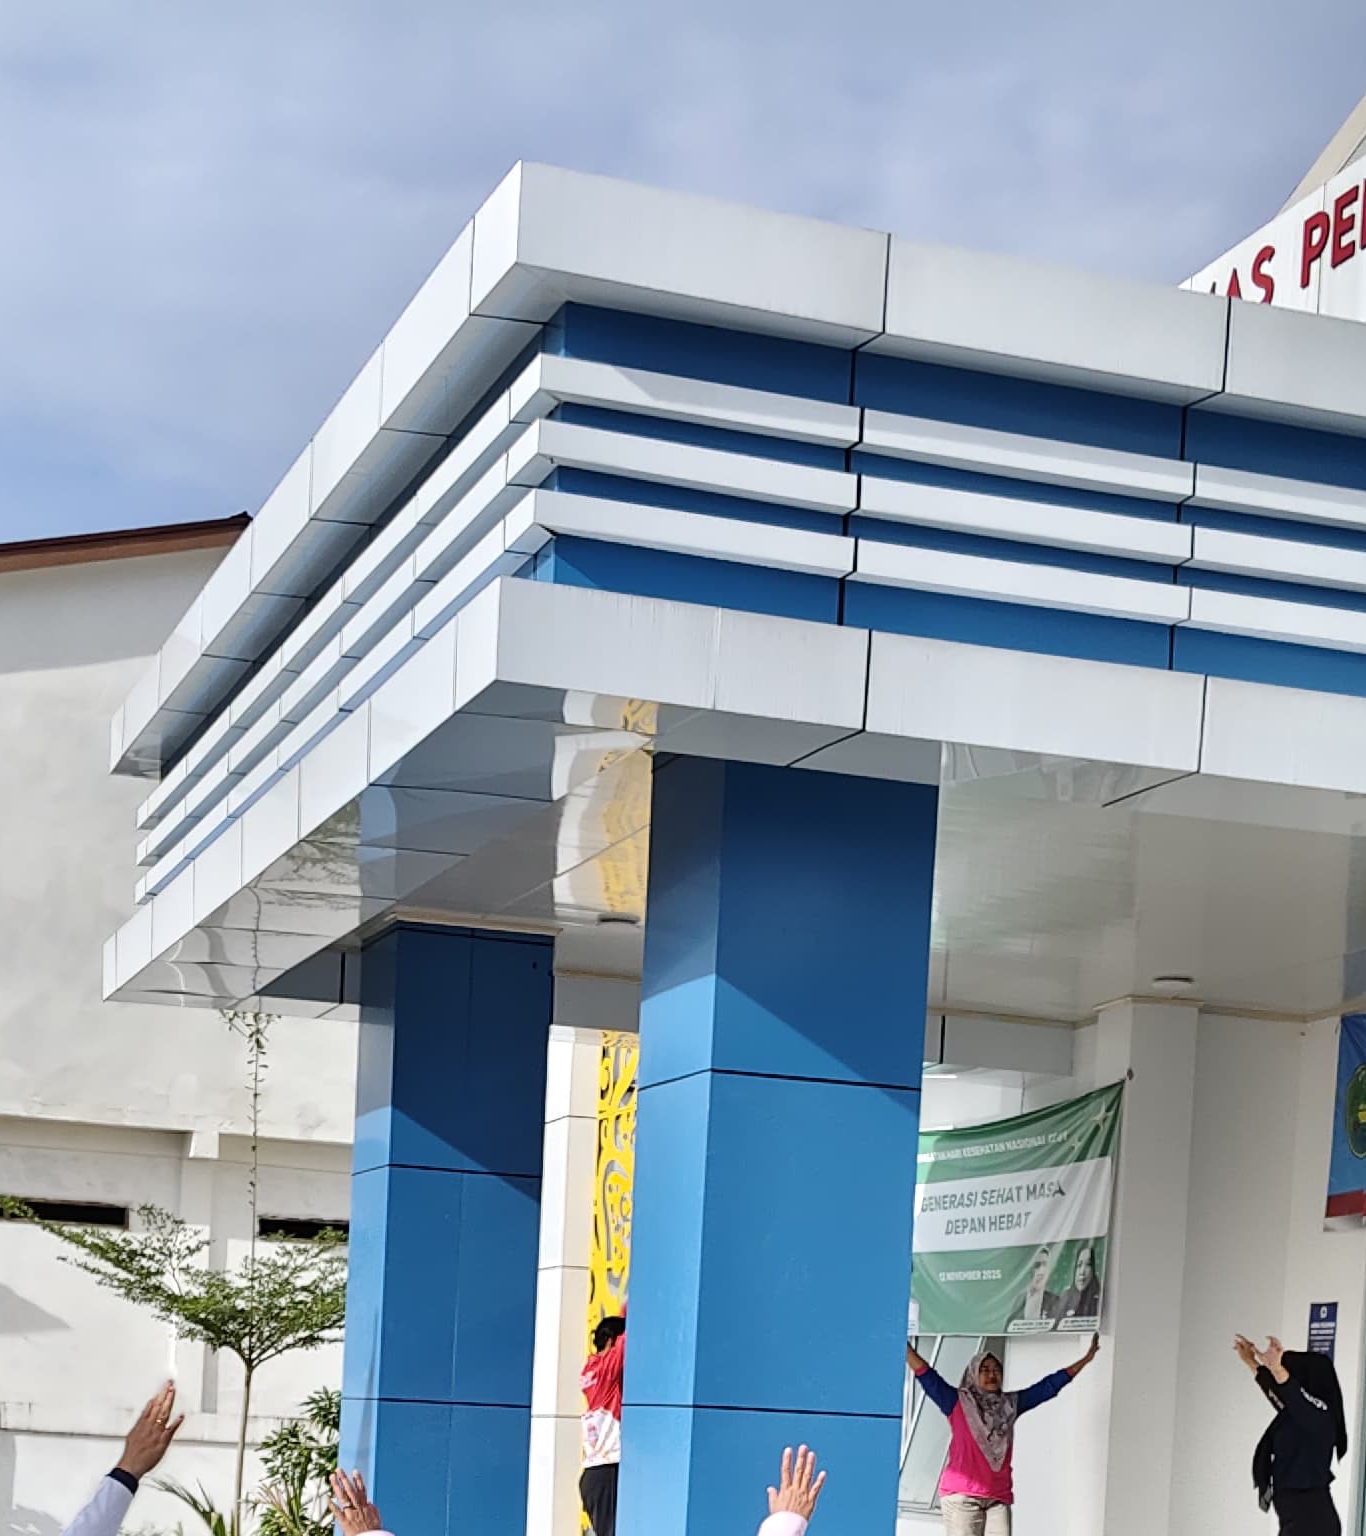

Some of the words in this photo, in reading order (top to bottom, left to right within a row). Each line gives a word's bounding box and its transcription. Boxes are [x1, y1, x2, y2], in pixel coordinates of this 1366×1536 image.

[921, 1191, 978, 1212] GENERASI
[979, 1186, 1023, 1206] SEHAT
[1026, 1180, 1066, 1200] MASA
[945, 1217, 986, 1235] DEPAN
[989, 1212, 1032, 1232] HEBAT
